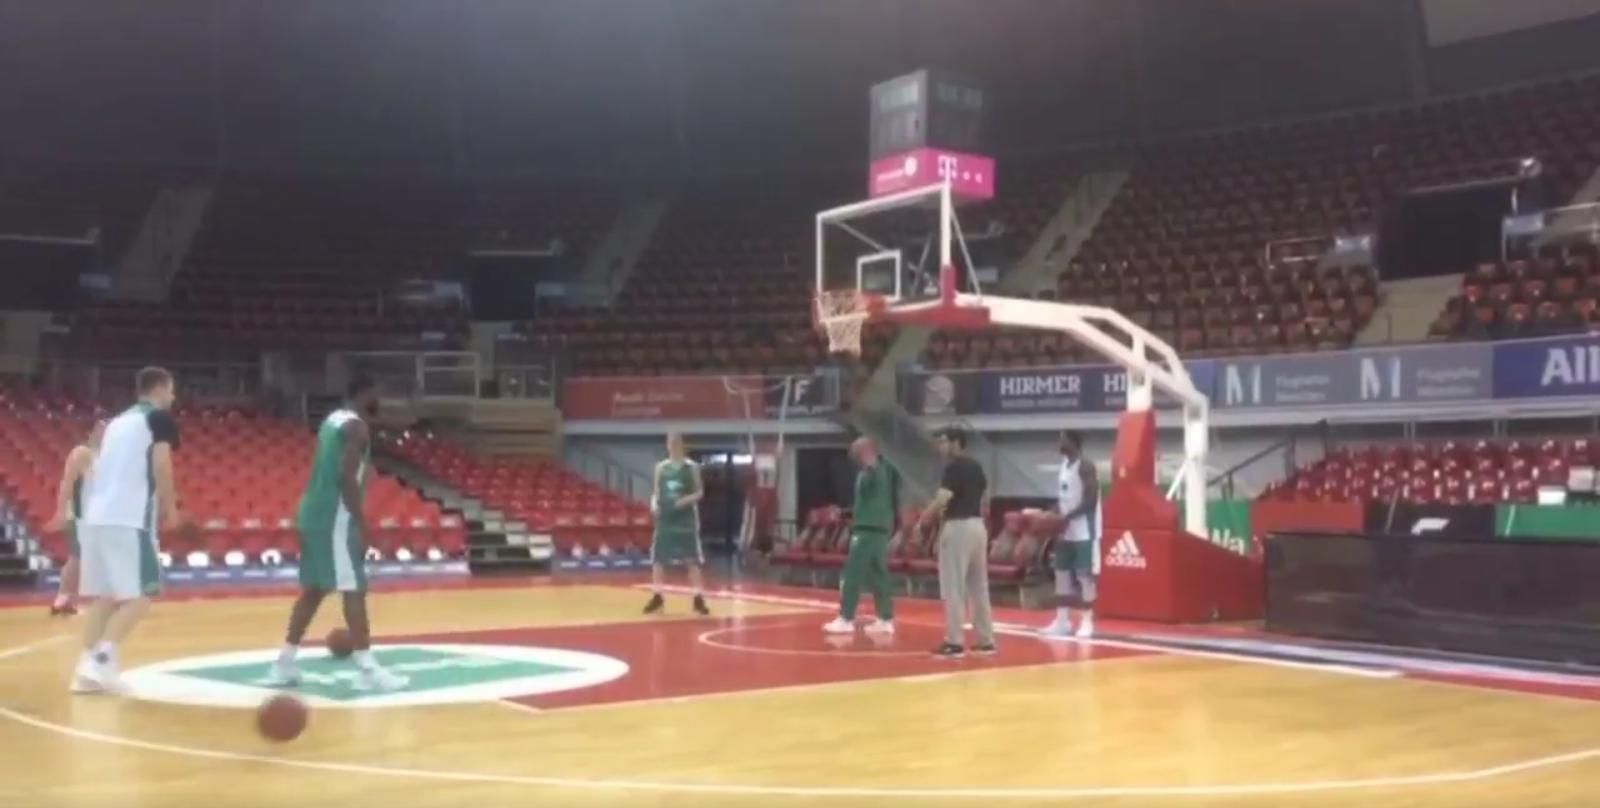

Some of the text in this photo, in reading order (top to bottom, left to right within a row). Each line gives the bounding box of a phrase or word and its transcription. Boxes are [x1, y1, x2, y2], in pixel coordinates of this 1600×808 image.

[1541, 346, 1600, 386] All
[1000, 375, 1081, 395] HIRMER
[1105, 554, 1147, 569] adidas
